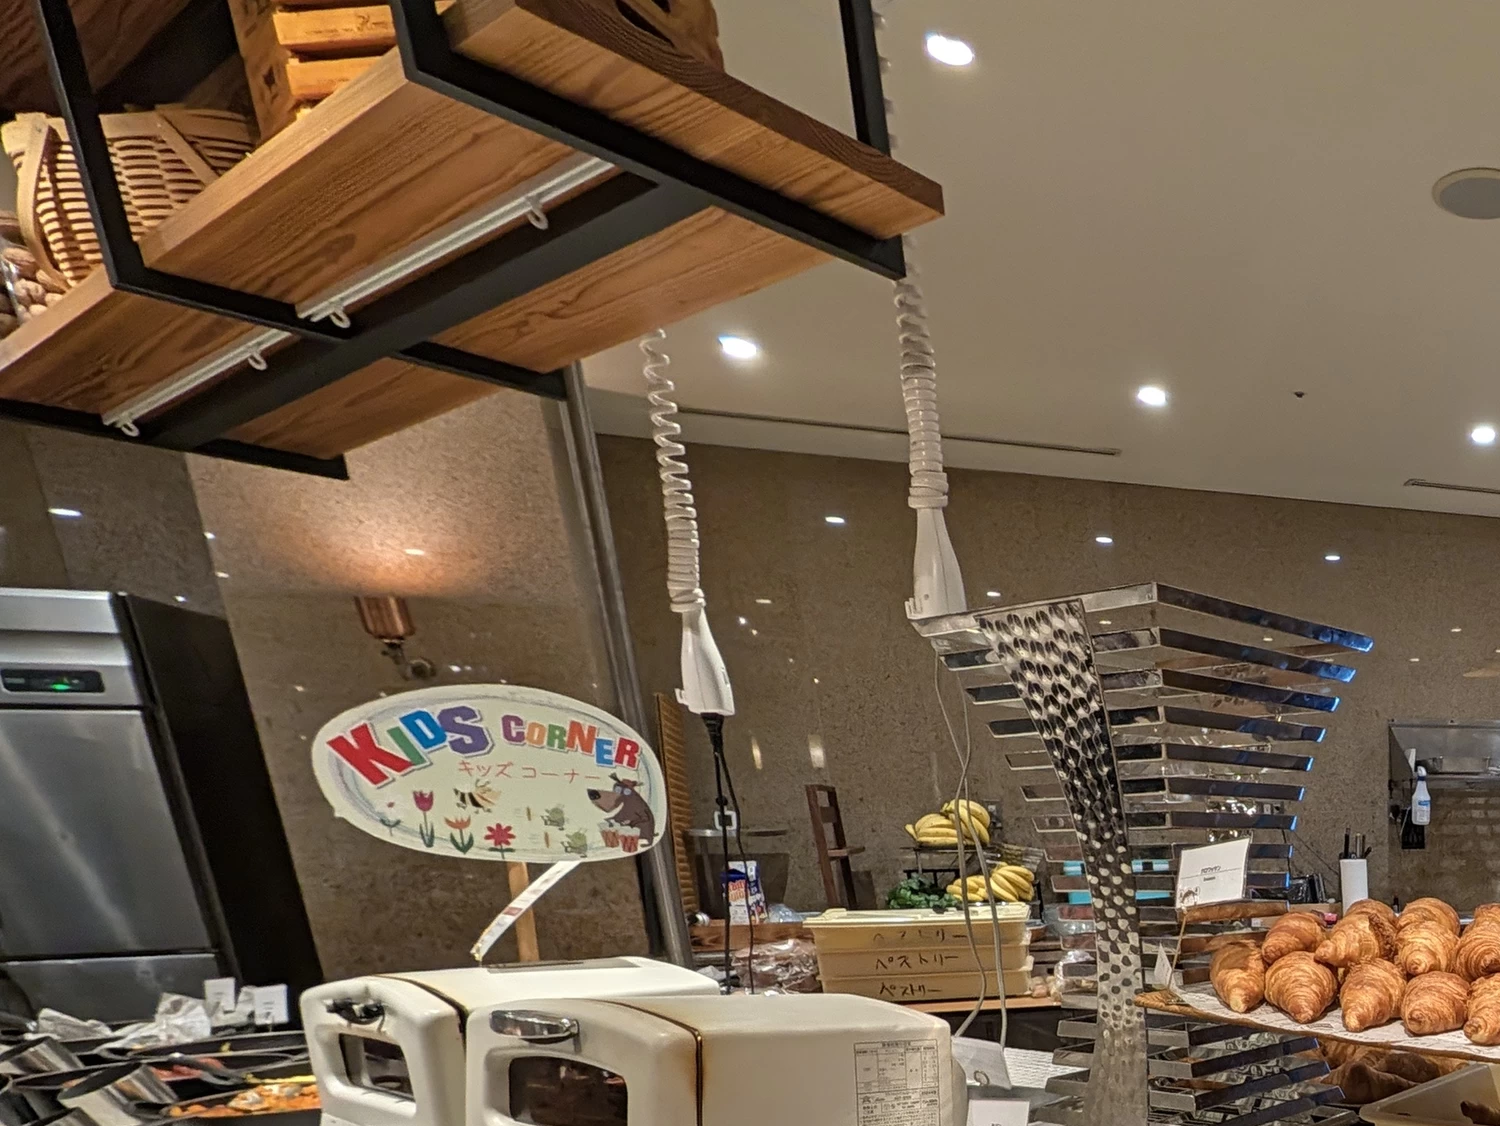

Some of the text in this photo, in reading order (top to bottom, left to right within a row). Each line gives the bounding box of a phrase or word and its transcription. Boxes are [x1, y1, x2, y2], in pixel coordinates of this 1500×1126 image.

[326, 706, 642, 787] KIDS CORNER
[876, 953, 959, 969] ペストリー
[880, 982, 942, 997] ペストリー
